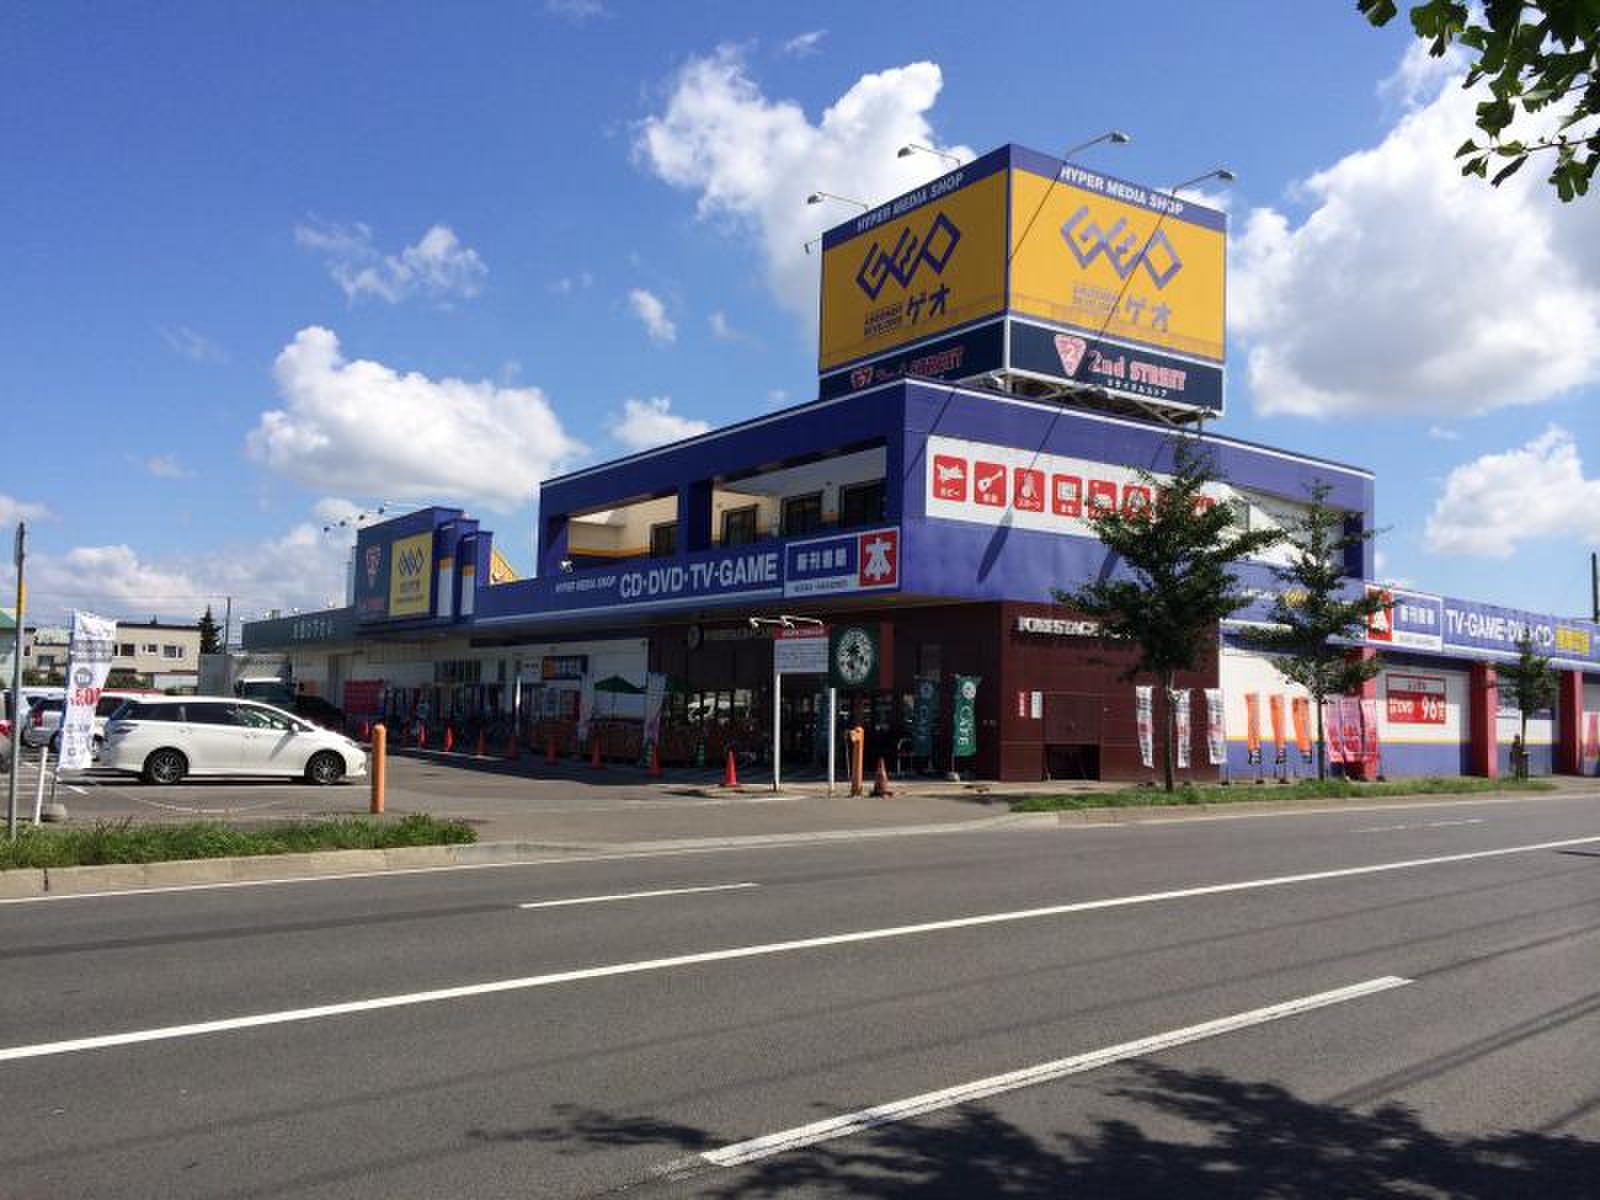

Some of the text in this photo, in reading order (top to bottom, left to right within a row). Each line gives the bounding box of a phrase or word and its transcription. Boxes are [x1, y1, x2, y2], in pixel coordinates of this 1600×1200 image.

[857, 207, 893, 232] HYPER
[929, 172, 964, 198] SHOP
[1060, 165, 1184, 214] HYPER MEDIA SHOP
[855, 210, 961, 300] GEO
[1060, 204, 1182, 289] GEO
[906, 283, 951, 325] ゲオ
[1124, 293, 1172, 333] ゲオ
[1088, 350, 1125, 379] 2nd
[1129, 360, 1186, 391] STREET
[864, 537, 892, 580] 本
[960, 705, 975, 746] CAFE
